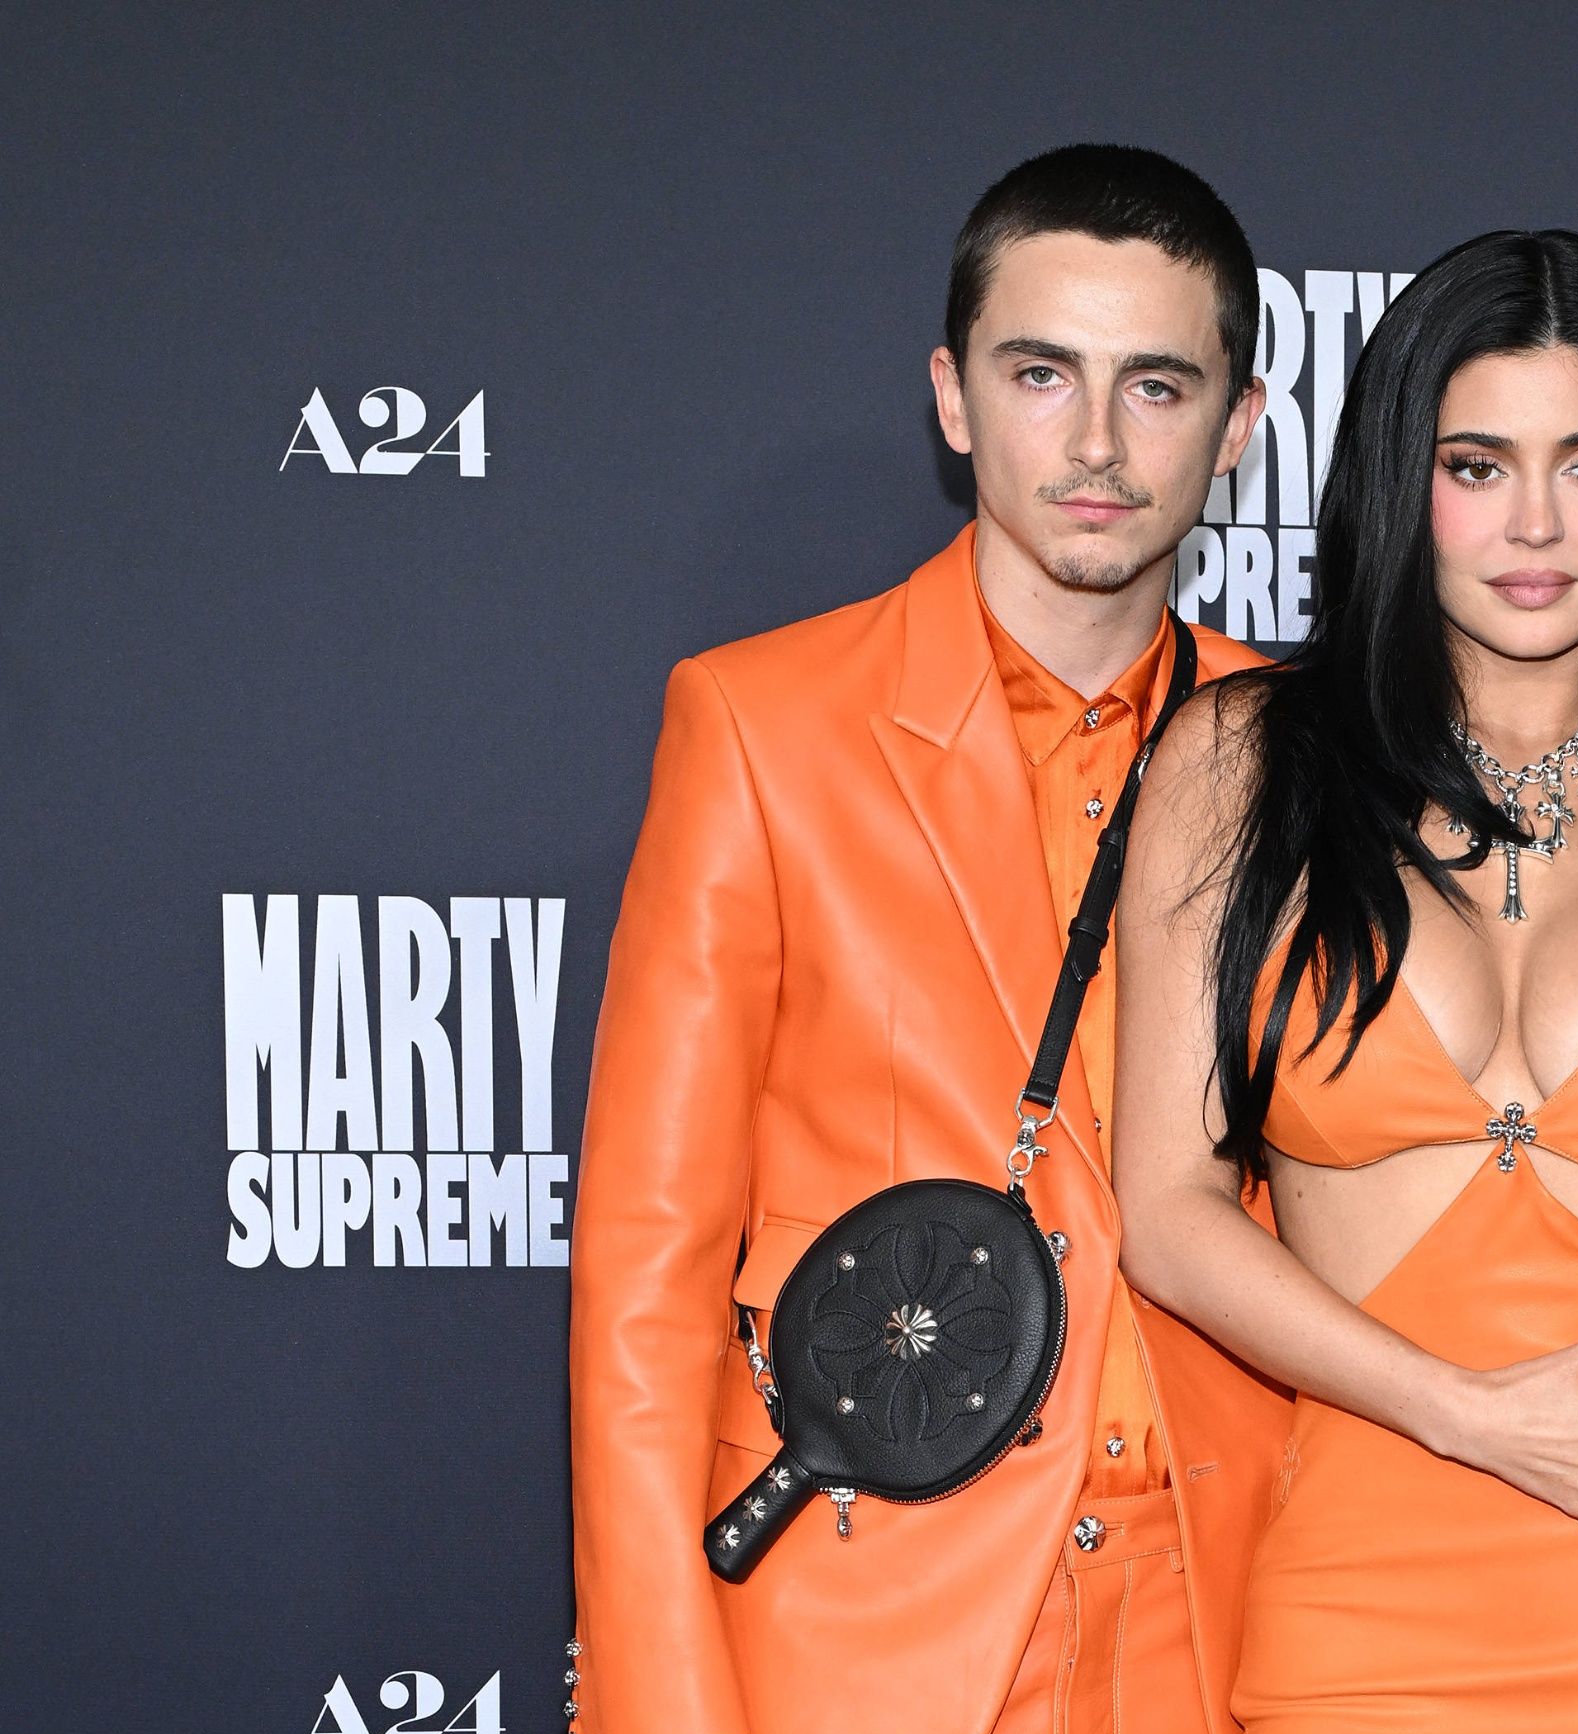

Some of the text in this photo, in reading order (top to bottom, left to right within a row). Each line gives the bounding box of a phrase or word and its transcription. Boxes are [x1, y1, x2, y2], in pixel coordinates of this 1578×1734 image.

[279, 386, 491, 478] A24
[222, 893, 566, 1151] MARTY
[226, 1151, 570, 1269] SUPREME
